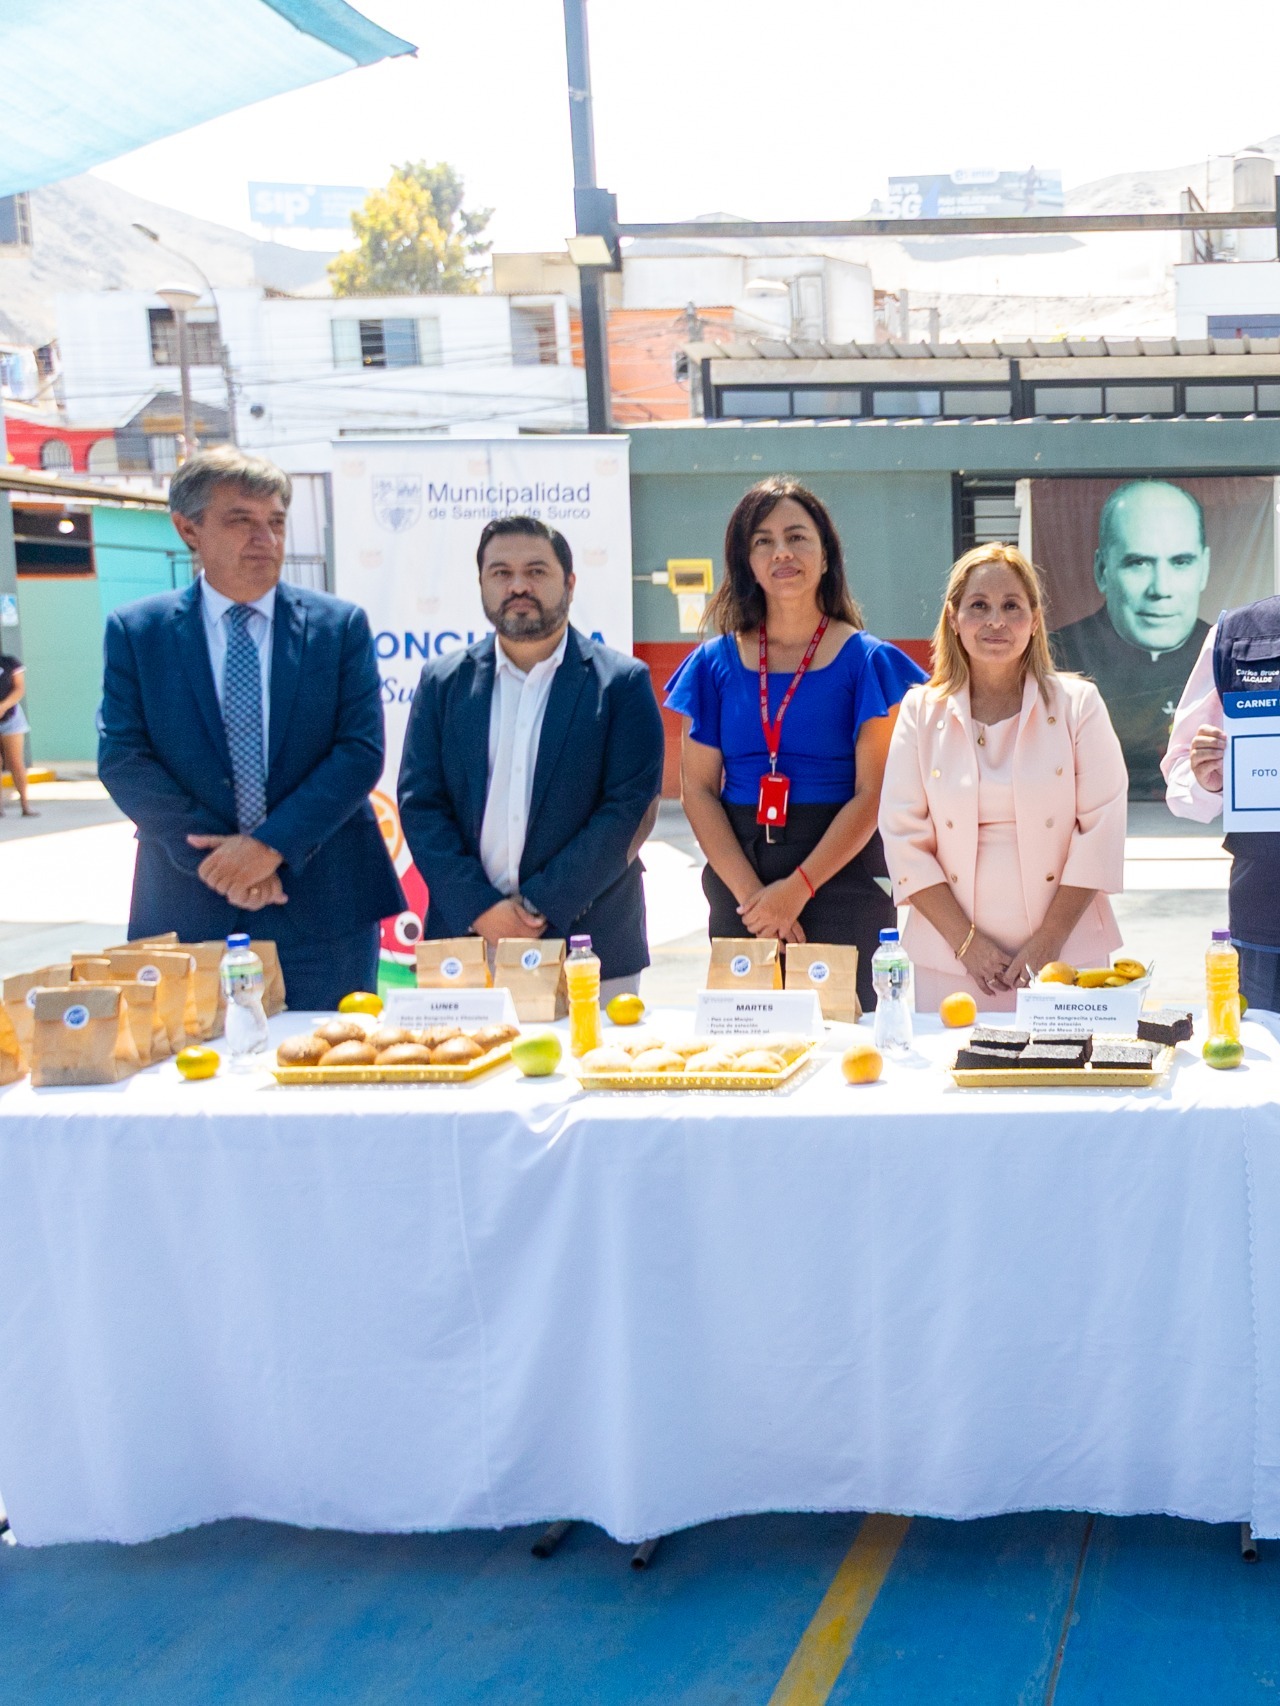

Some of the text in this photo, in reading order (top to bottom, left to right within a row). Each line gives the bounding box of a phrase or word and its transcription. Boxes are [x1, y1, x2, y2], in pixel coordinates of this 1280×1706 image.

[880, 195, 923, 219] 5G
[428, 482, 591, 506] Municipalidad
[429, 506, 446, 519] de
[452, 506, 518, 520] Santiago
[548, 506, 590, 519] Surco
[1236, 698, 1278, 709] CARNET
[1252, 768, 1278, 778] FOTO
[736, 1004, 774, 1012] MARTES
[1054, 1004, 1108, 1012] MIERCOLES
